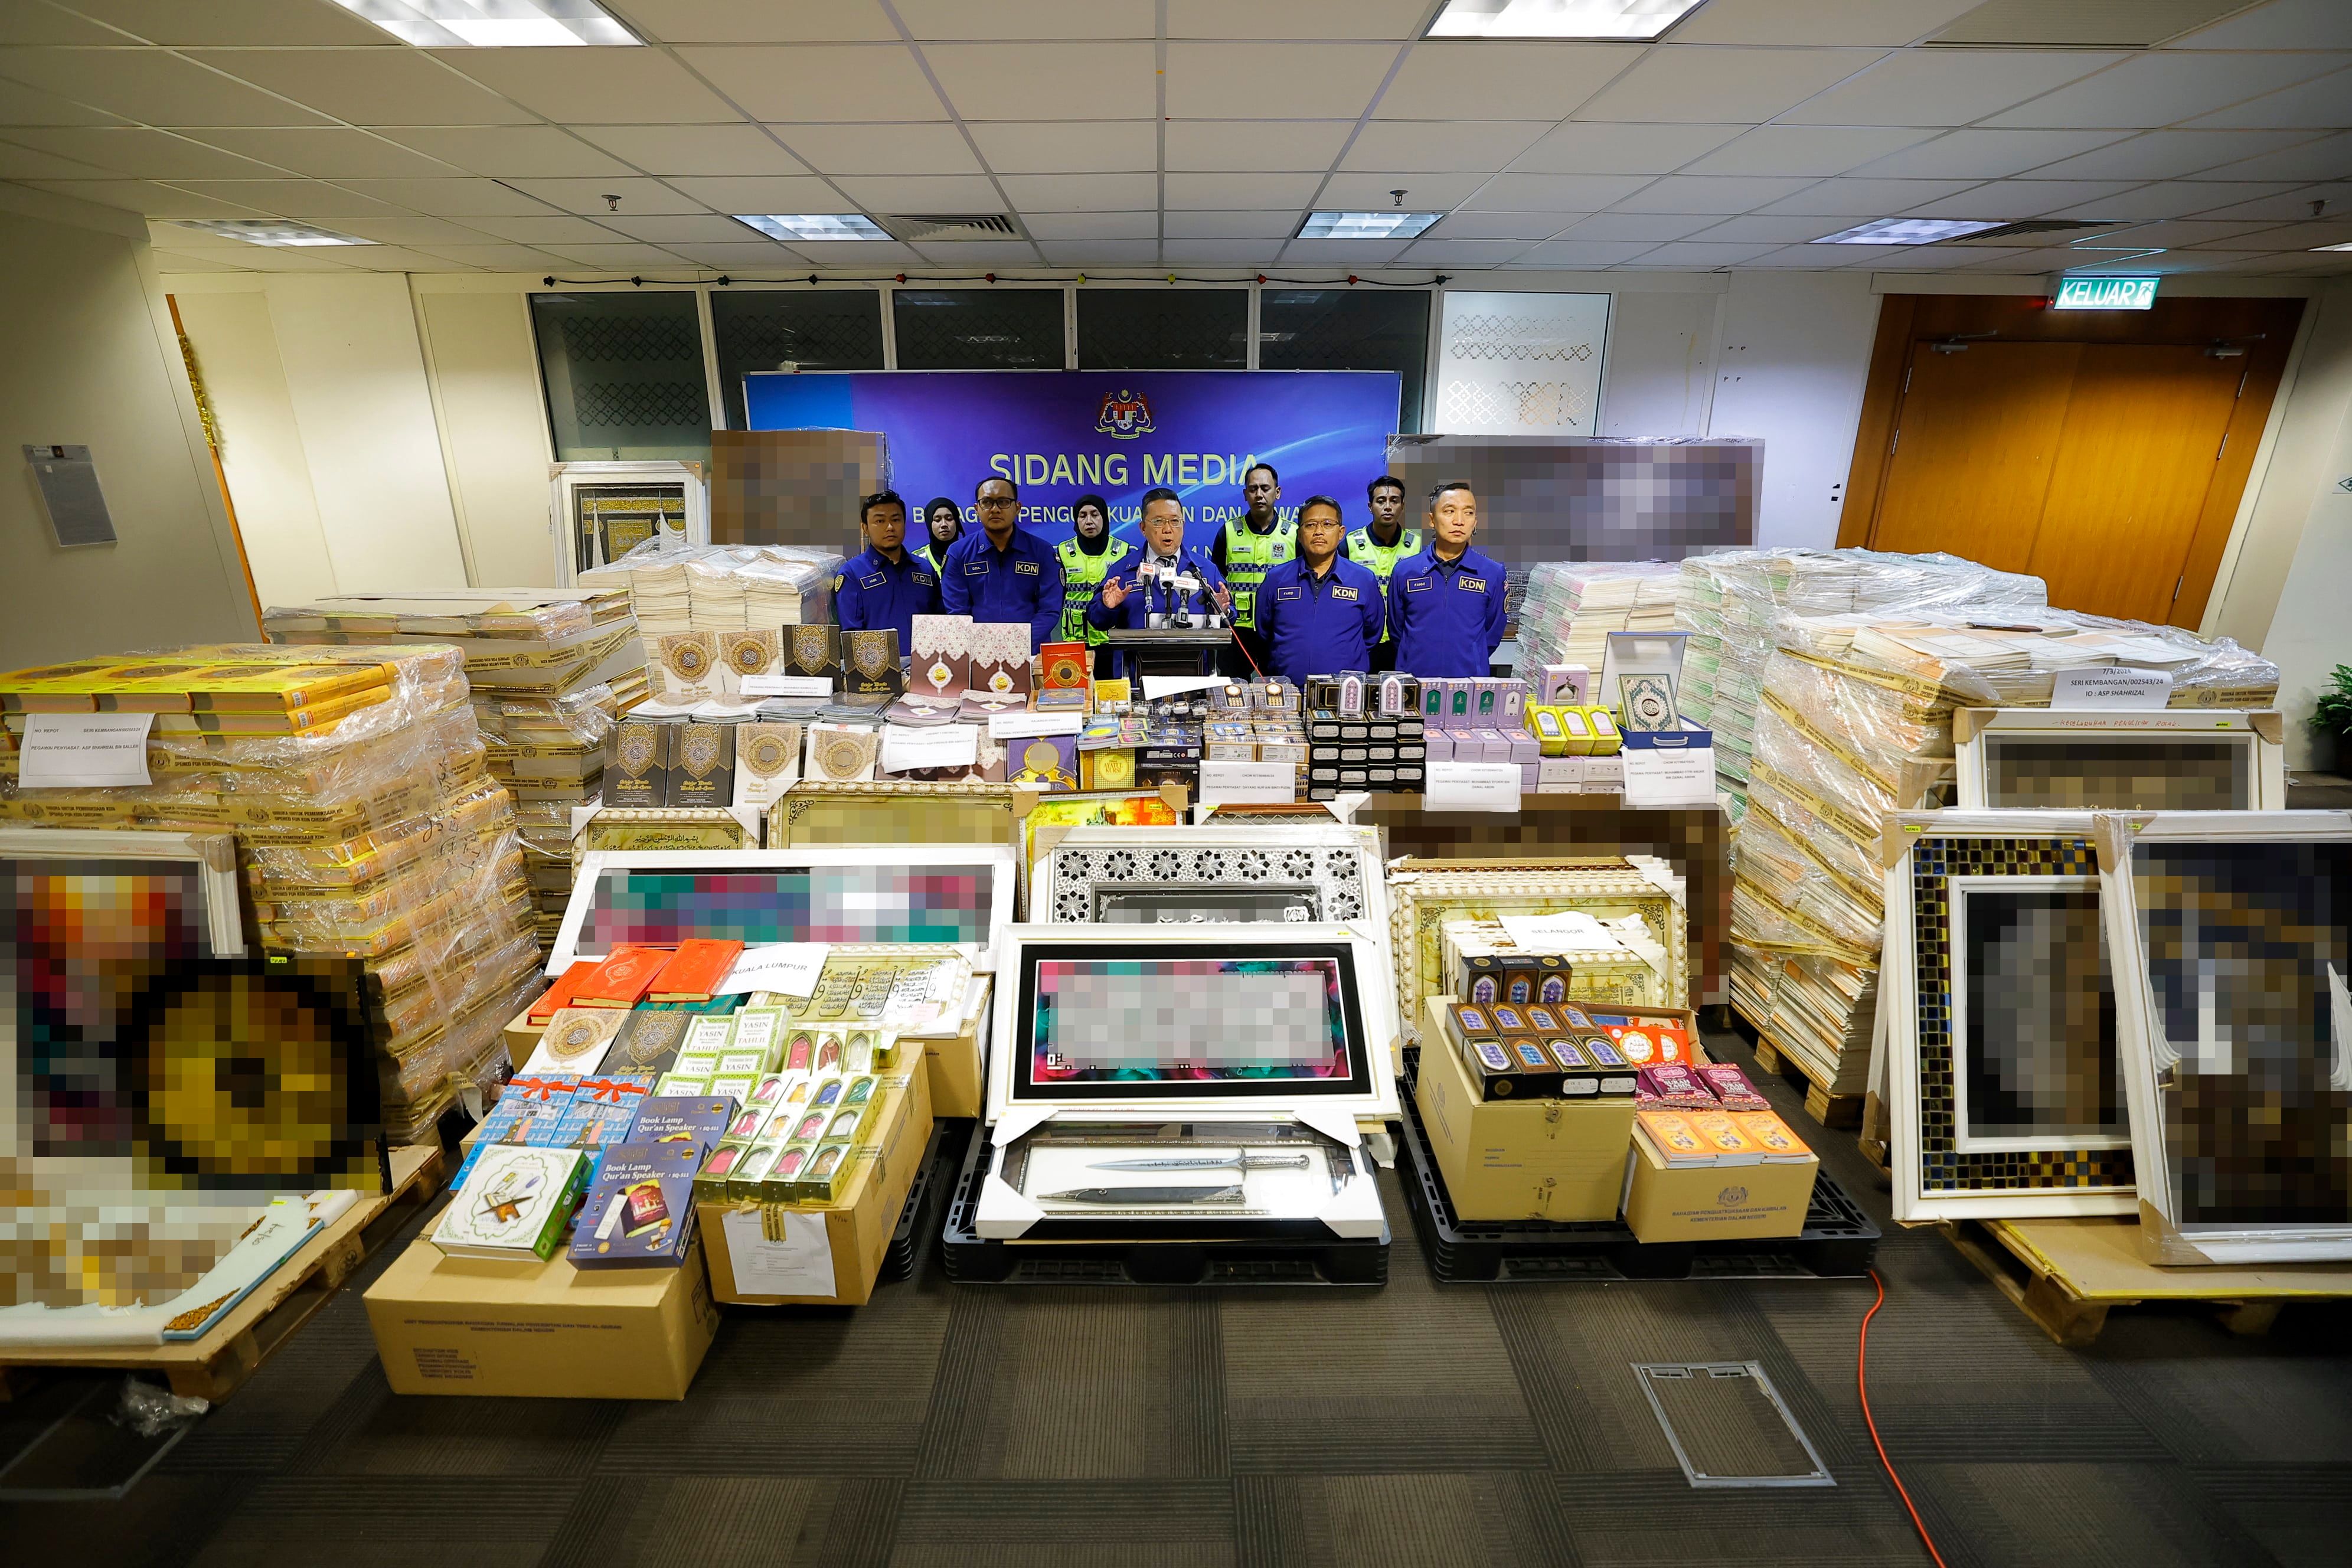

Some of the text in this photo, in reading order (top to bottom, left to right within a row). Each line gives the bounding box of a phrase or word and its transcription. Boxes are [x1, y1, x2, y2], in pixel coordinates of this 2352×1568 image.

[2059, 281, 2136, 305] KELUAR
[989, 453, 1259, 486] SIDANG MEDIA
[1203, 506, 1241, 523] DAN
[1017, 563, 1038, 573] KDN
[914, 573, 930, 584] KDN
[1461, 579, 1484, 590] KDN
[1334, 589, 1357, 599] KDN
[2085, 678, 2164, 687] KEMBANGAN/002543/24
[2110, 689, 2145, 697] SHAHRIZAL
[732, 962, 808, 975] KUALA LUMPUR
[638, 1124, 664, 1132] Qur'an
[605, 1164, 651, 1172] Book Lamp
[602, 1171, 632, 1180] Qur'an
[633, 1171, 665, 1180] Speaker
